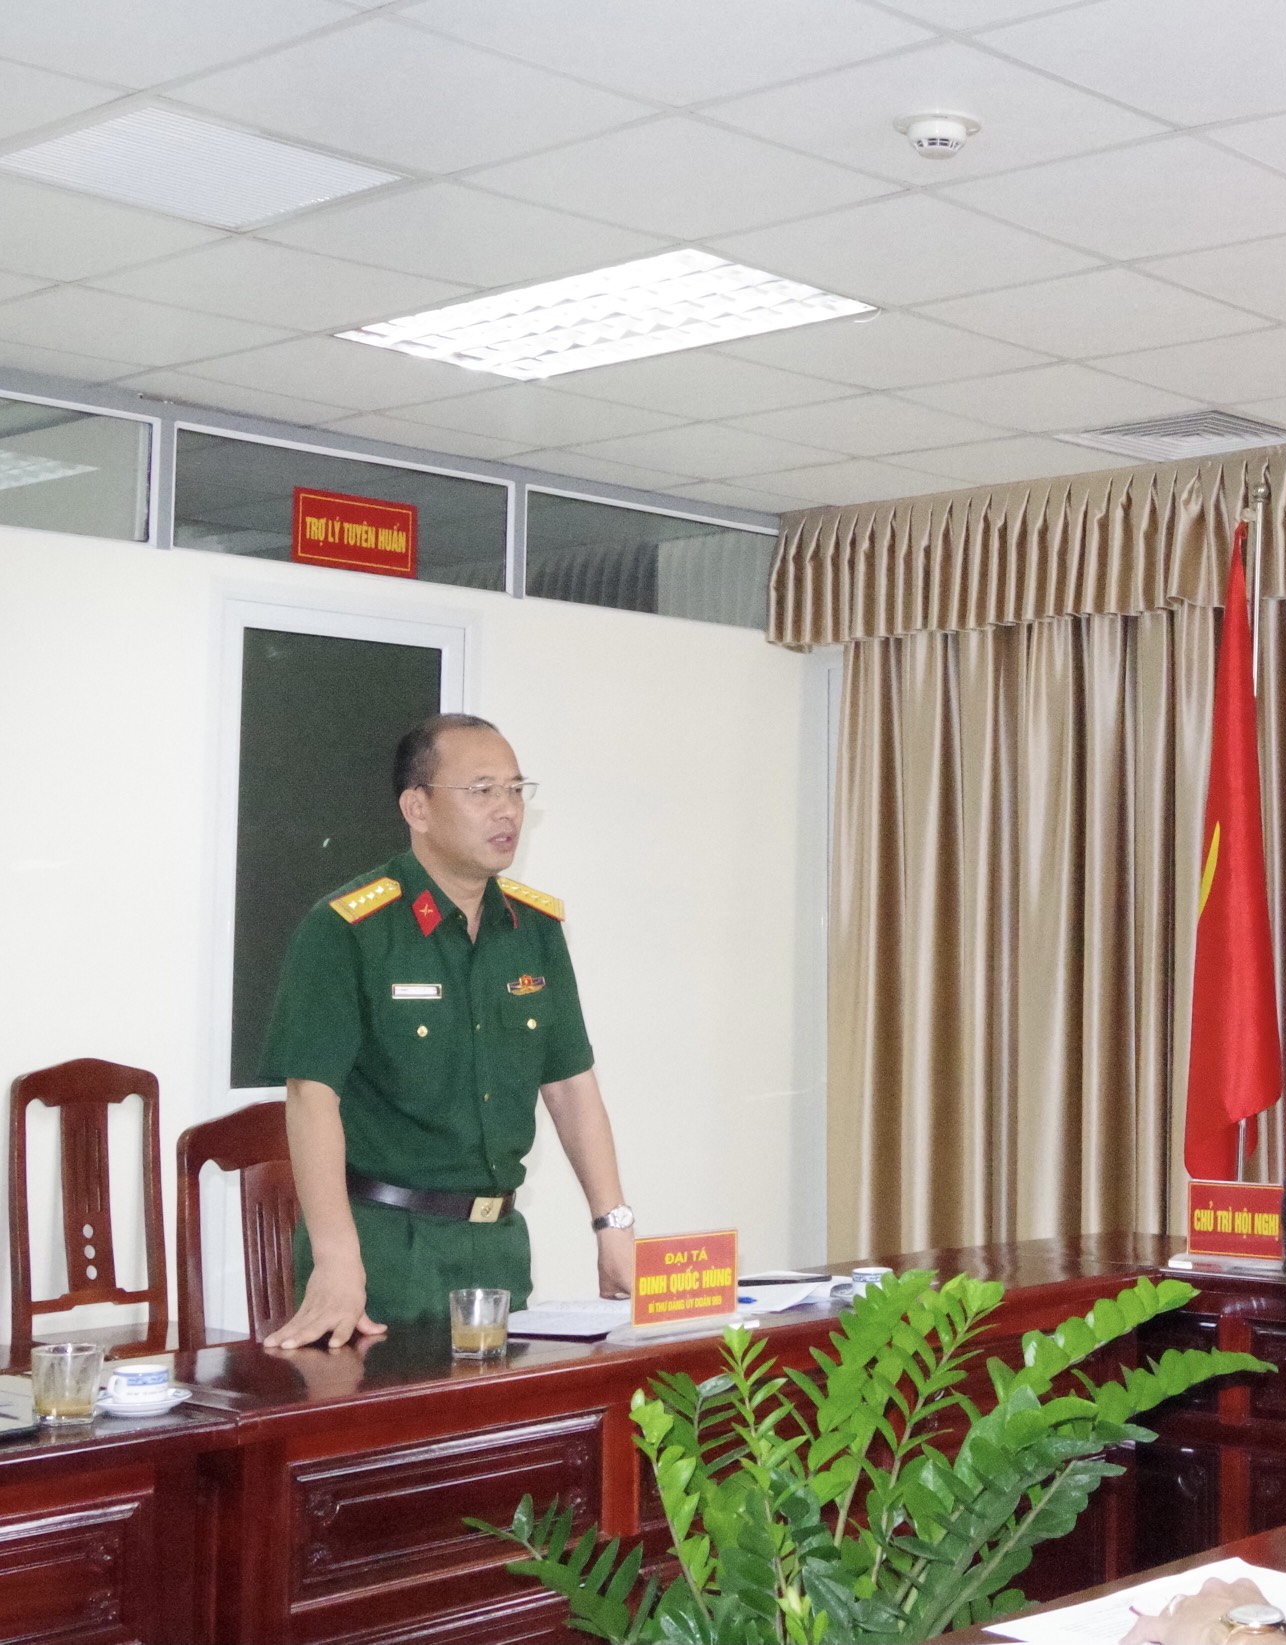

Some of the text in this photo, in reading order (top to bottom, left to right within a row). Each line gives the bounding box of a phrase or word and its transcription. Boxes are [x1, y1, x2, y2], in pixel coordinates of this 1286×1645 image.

[305, 516, 407, 553] TRỢ LÝ TUYÊN HUẤN
[1194, 1200, 1280, 1241] CHỦ TRÌ HỘI NGHỊ
[664, 1247, 709, 1266] ĐẠI TÁ
[669, 1265, 700, 1294] QUỐC
[702, 1265, 733, 1288] HÙNG
